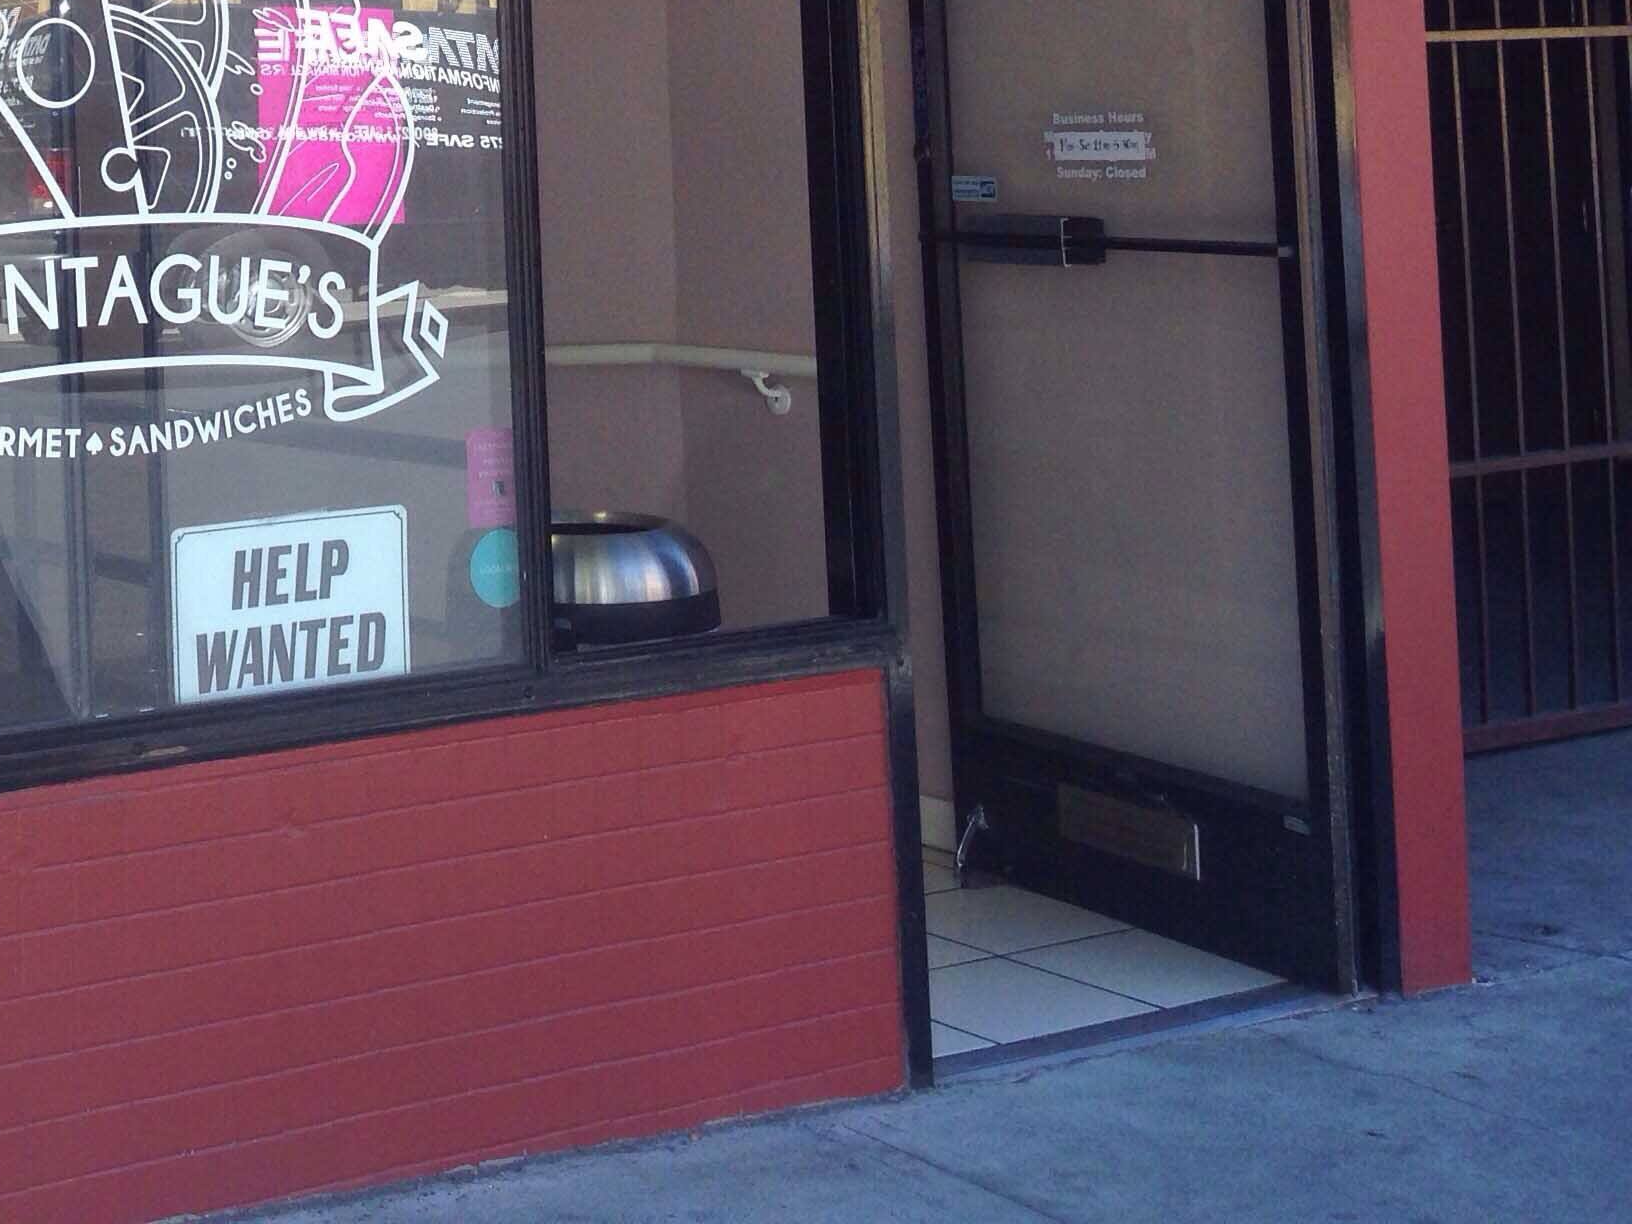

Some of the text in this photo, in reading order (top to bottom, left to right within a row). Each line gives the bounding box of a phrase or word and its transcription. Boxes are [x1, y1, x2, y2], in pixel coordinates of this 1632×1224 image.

[1053, 111, 1144, 125] Business Hours
[1105, 165, 1147, 179] Closed
[109, 388, 313, 457] SANDWICHES
[231, 538, 351, 611] HELP
[195, 611, 387, 696] WANTED
